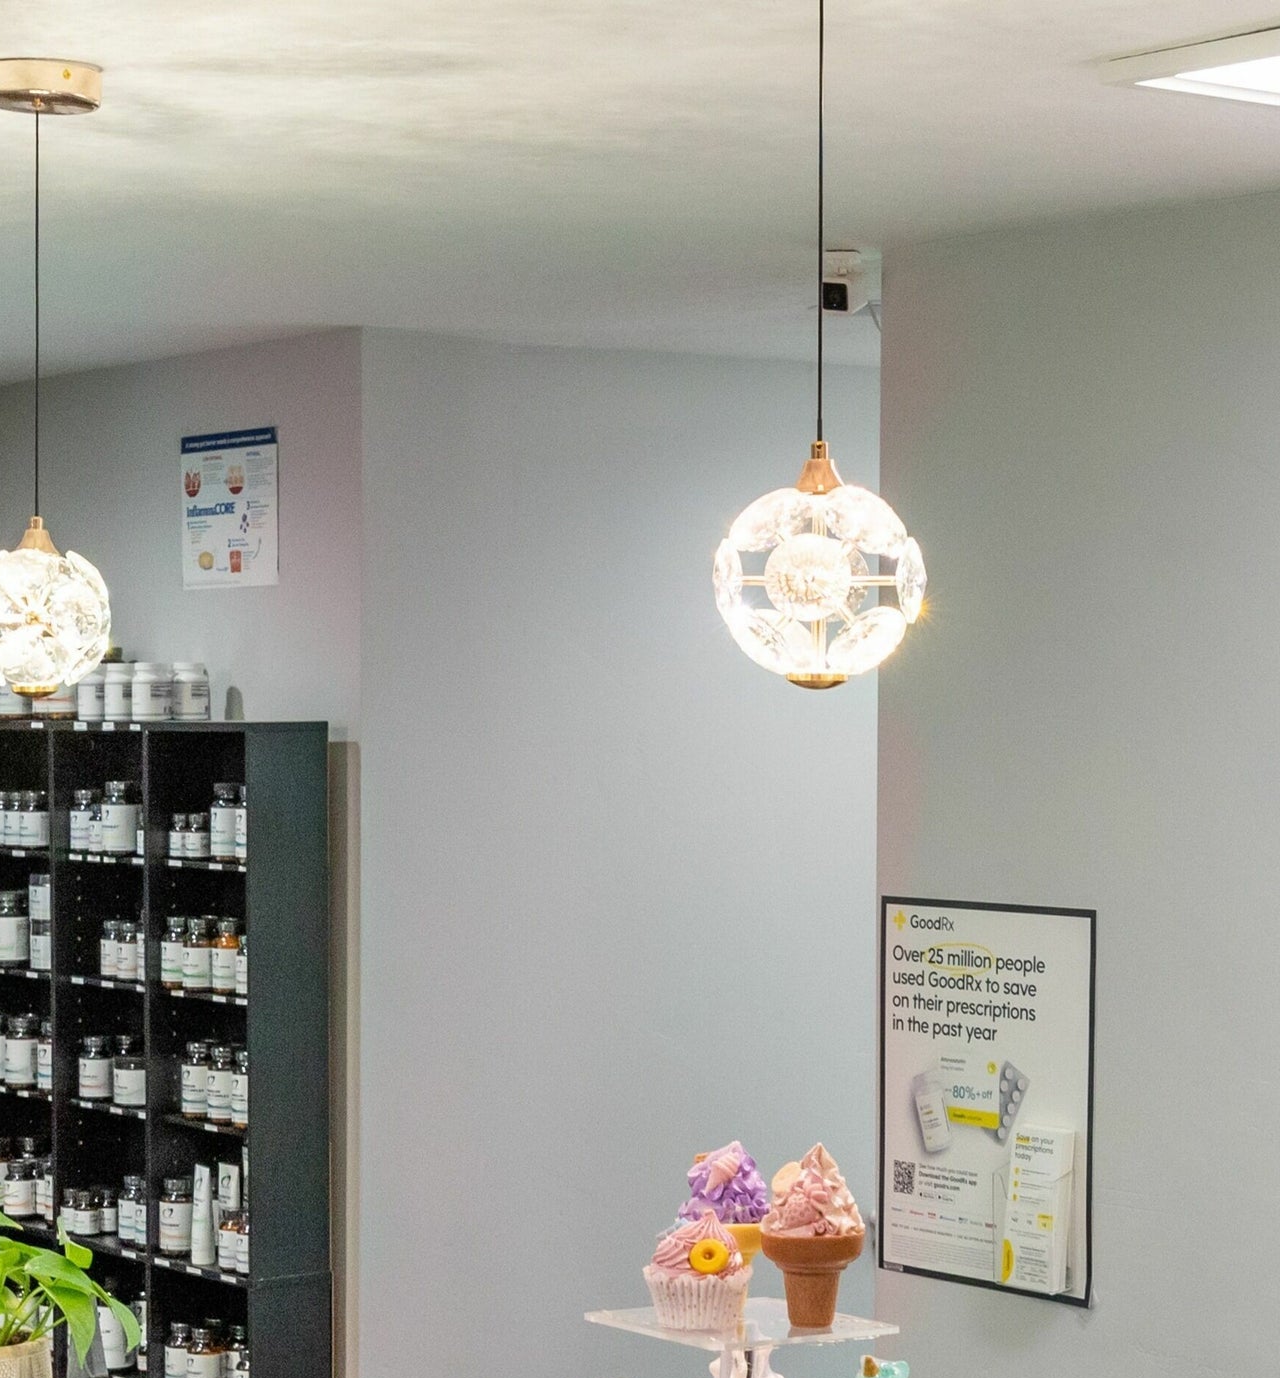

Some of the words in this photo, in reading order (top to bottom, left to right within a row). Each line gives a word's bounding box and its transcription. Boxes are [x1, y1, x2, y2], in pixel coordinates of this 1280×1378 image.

[910, 914, 954, 931] GoodRx
[892, 945, 925, 963] Over
[928, 947, 944, 964] 25
[947, 949, 992, 969] million
[995, 956, 1046, 977] people
[892, 970, 925, 987] used
[928, 971, 982, 992] GoodRx
[985, 978, 1000, 993] to
[1003, 982, 1037, 997] save
[892, 995, 909, 1009] on
[913, 992, 943, 1011] their
[946, 1000, 1036, 1022] prescriptions
[892, 1014, 904, 1031] in
[907, 1016, 929, 1034] the
[932, 1021, 963, 1039] past
[966, 1025, 998, 1043] year
[982, 1089, 993, 1100] off
